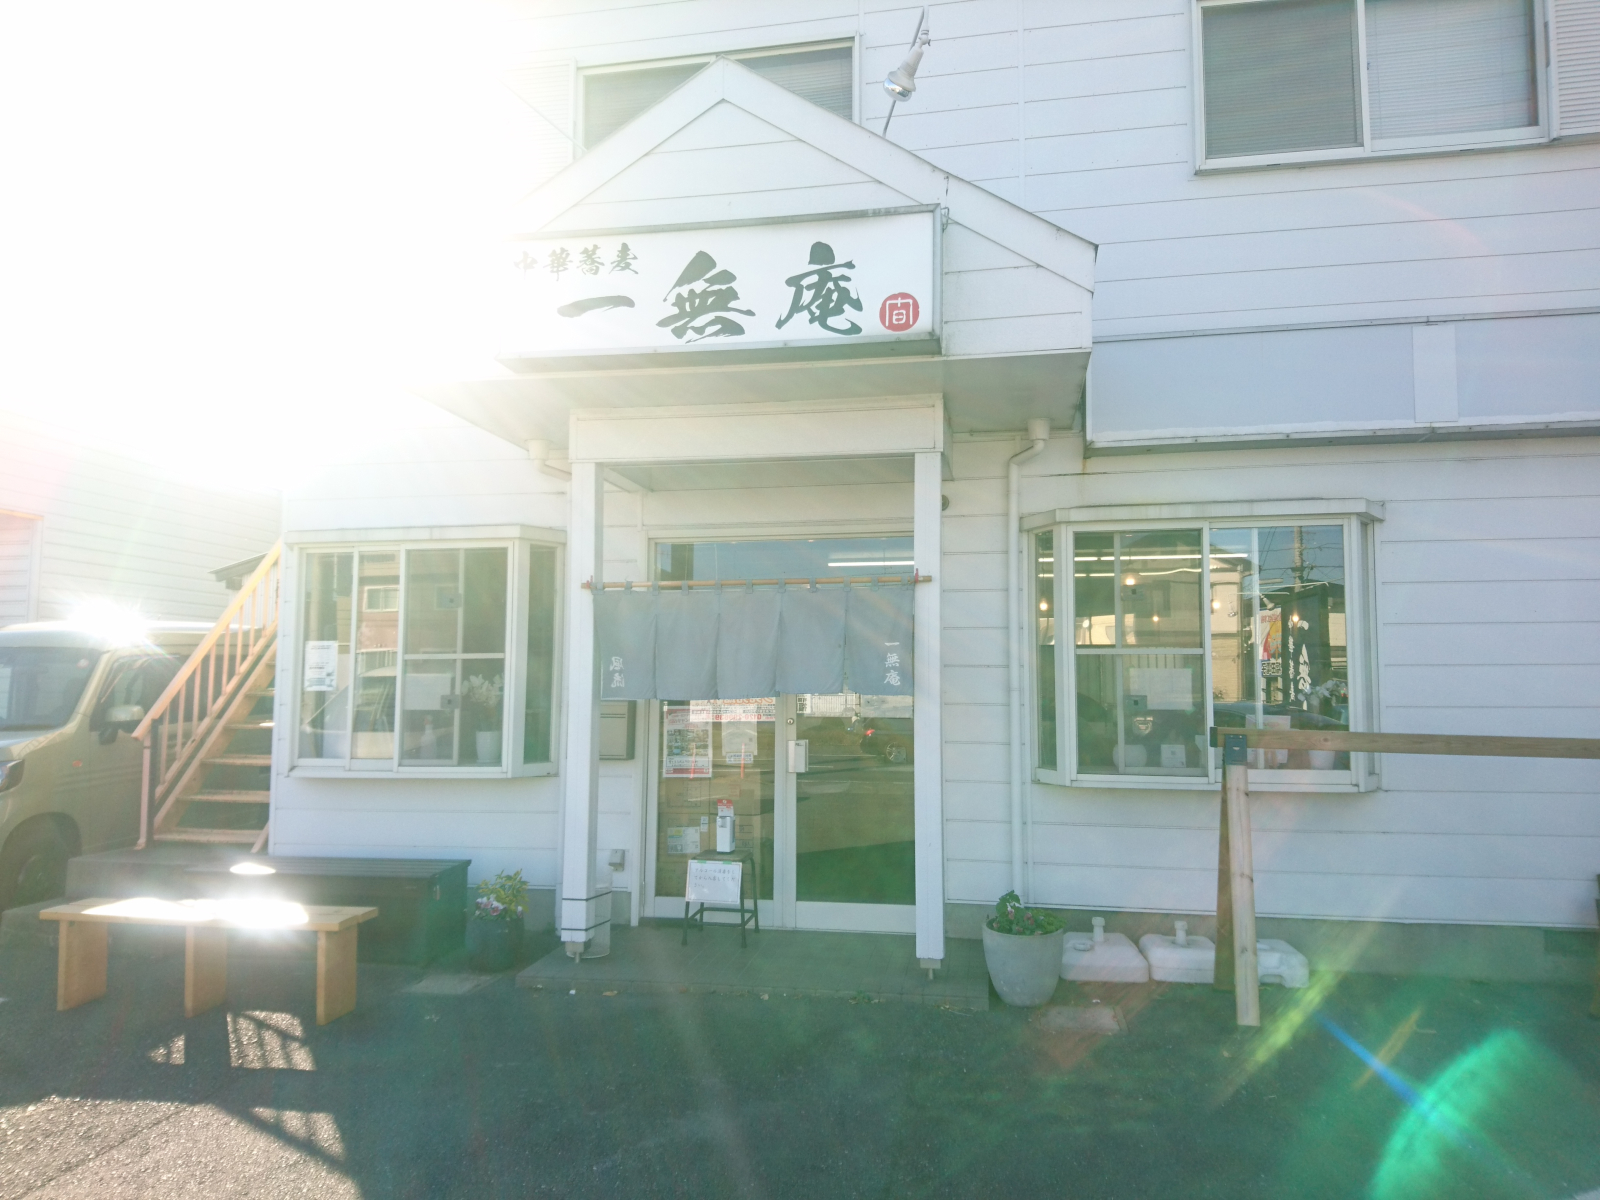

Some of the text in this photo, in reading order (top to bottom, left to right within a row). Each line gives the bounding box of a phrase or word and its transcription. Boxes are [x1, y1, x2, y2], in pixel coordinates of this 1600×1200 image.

[513, 242, 639, 282] 中華蕎麦
[557, 241, 863, 344] 一無庵
[883, 641, 901, 686] 一無庵
